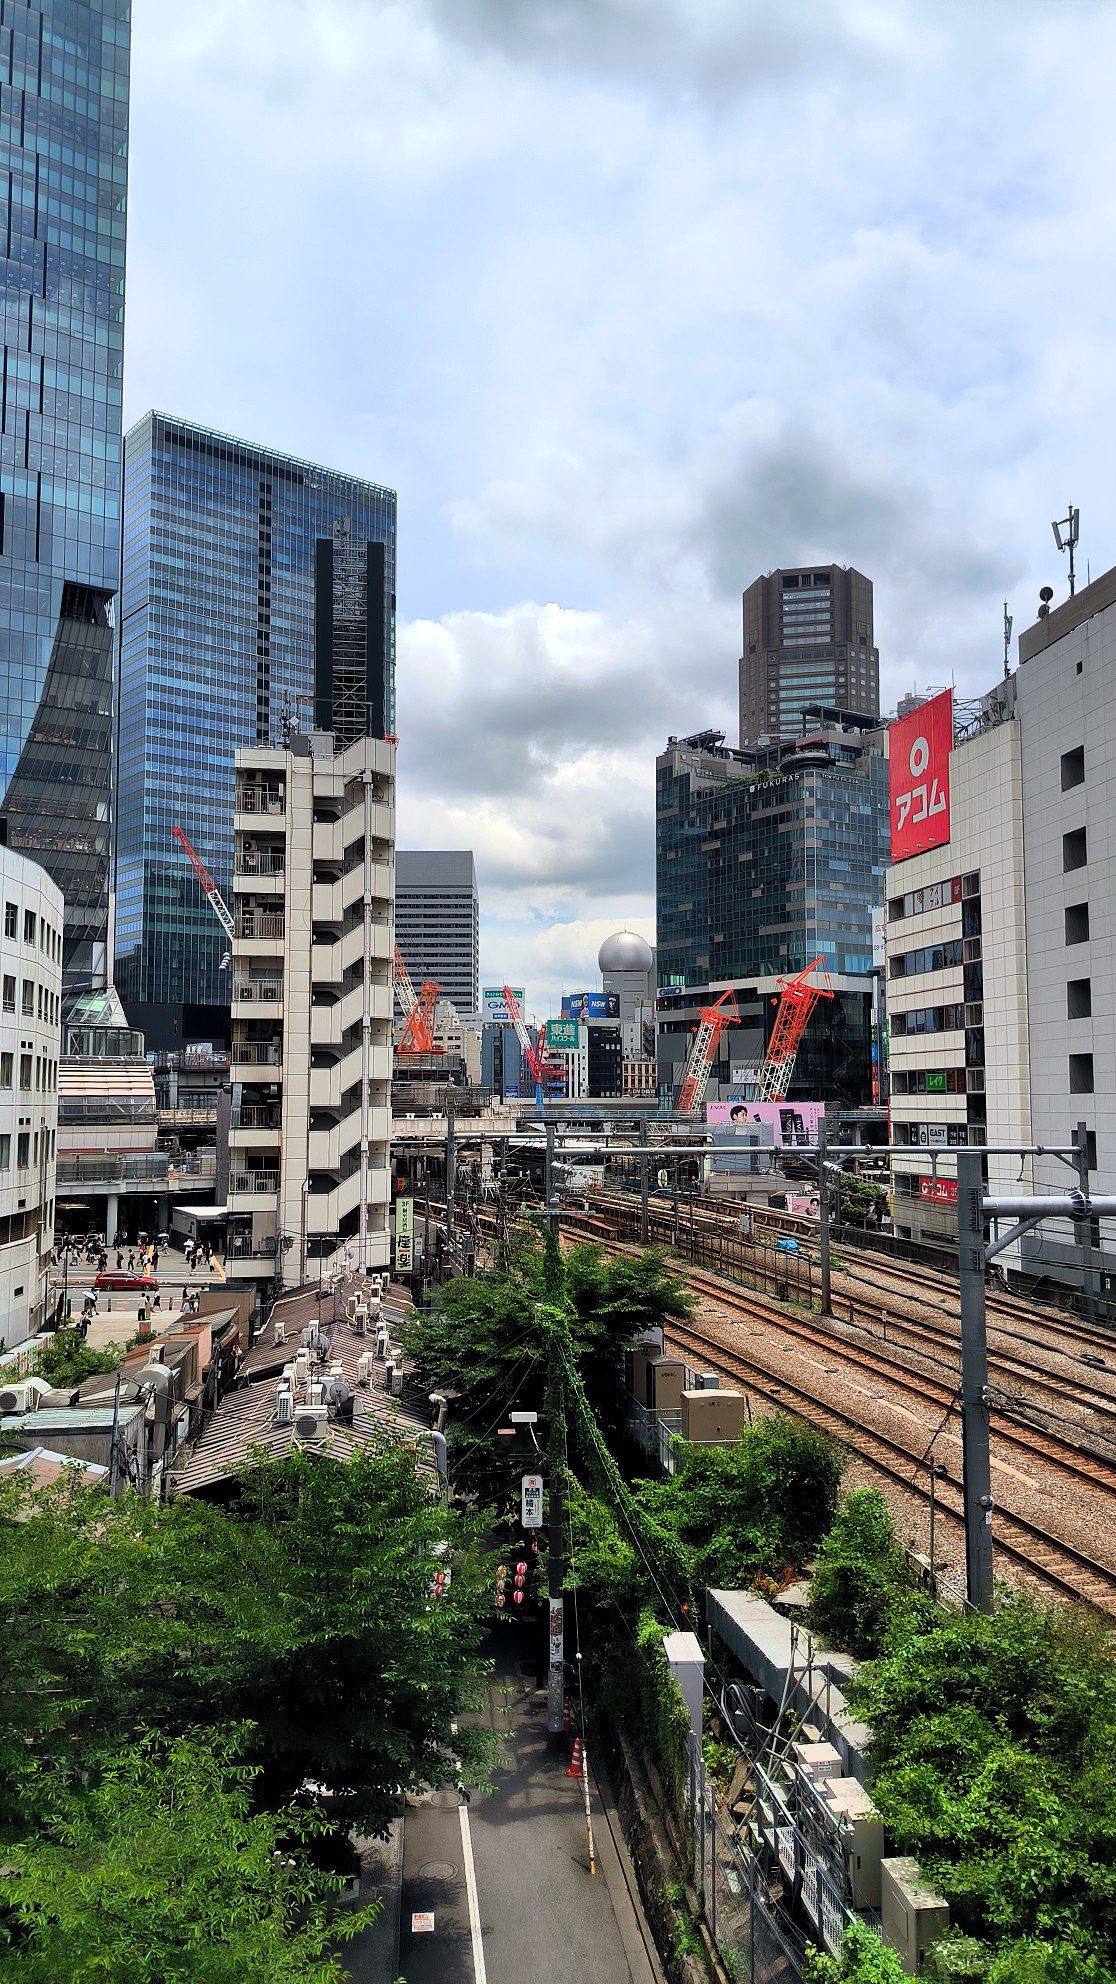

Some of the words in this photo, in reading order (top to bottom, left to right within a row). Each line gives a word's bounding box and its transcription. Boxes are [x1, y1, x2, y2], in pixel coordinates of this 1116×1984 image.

[757, 773, 800, 791] FUKURAS
[895, 778, 947, 832] アコム
[591, 1000, 606, 1008] NSW
[550, 1023, 575, 1035] 東進
[929, 1075, 943, 1086] レイク
[930, 1129, 946, 1137] EAST
